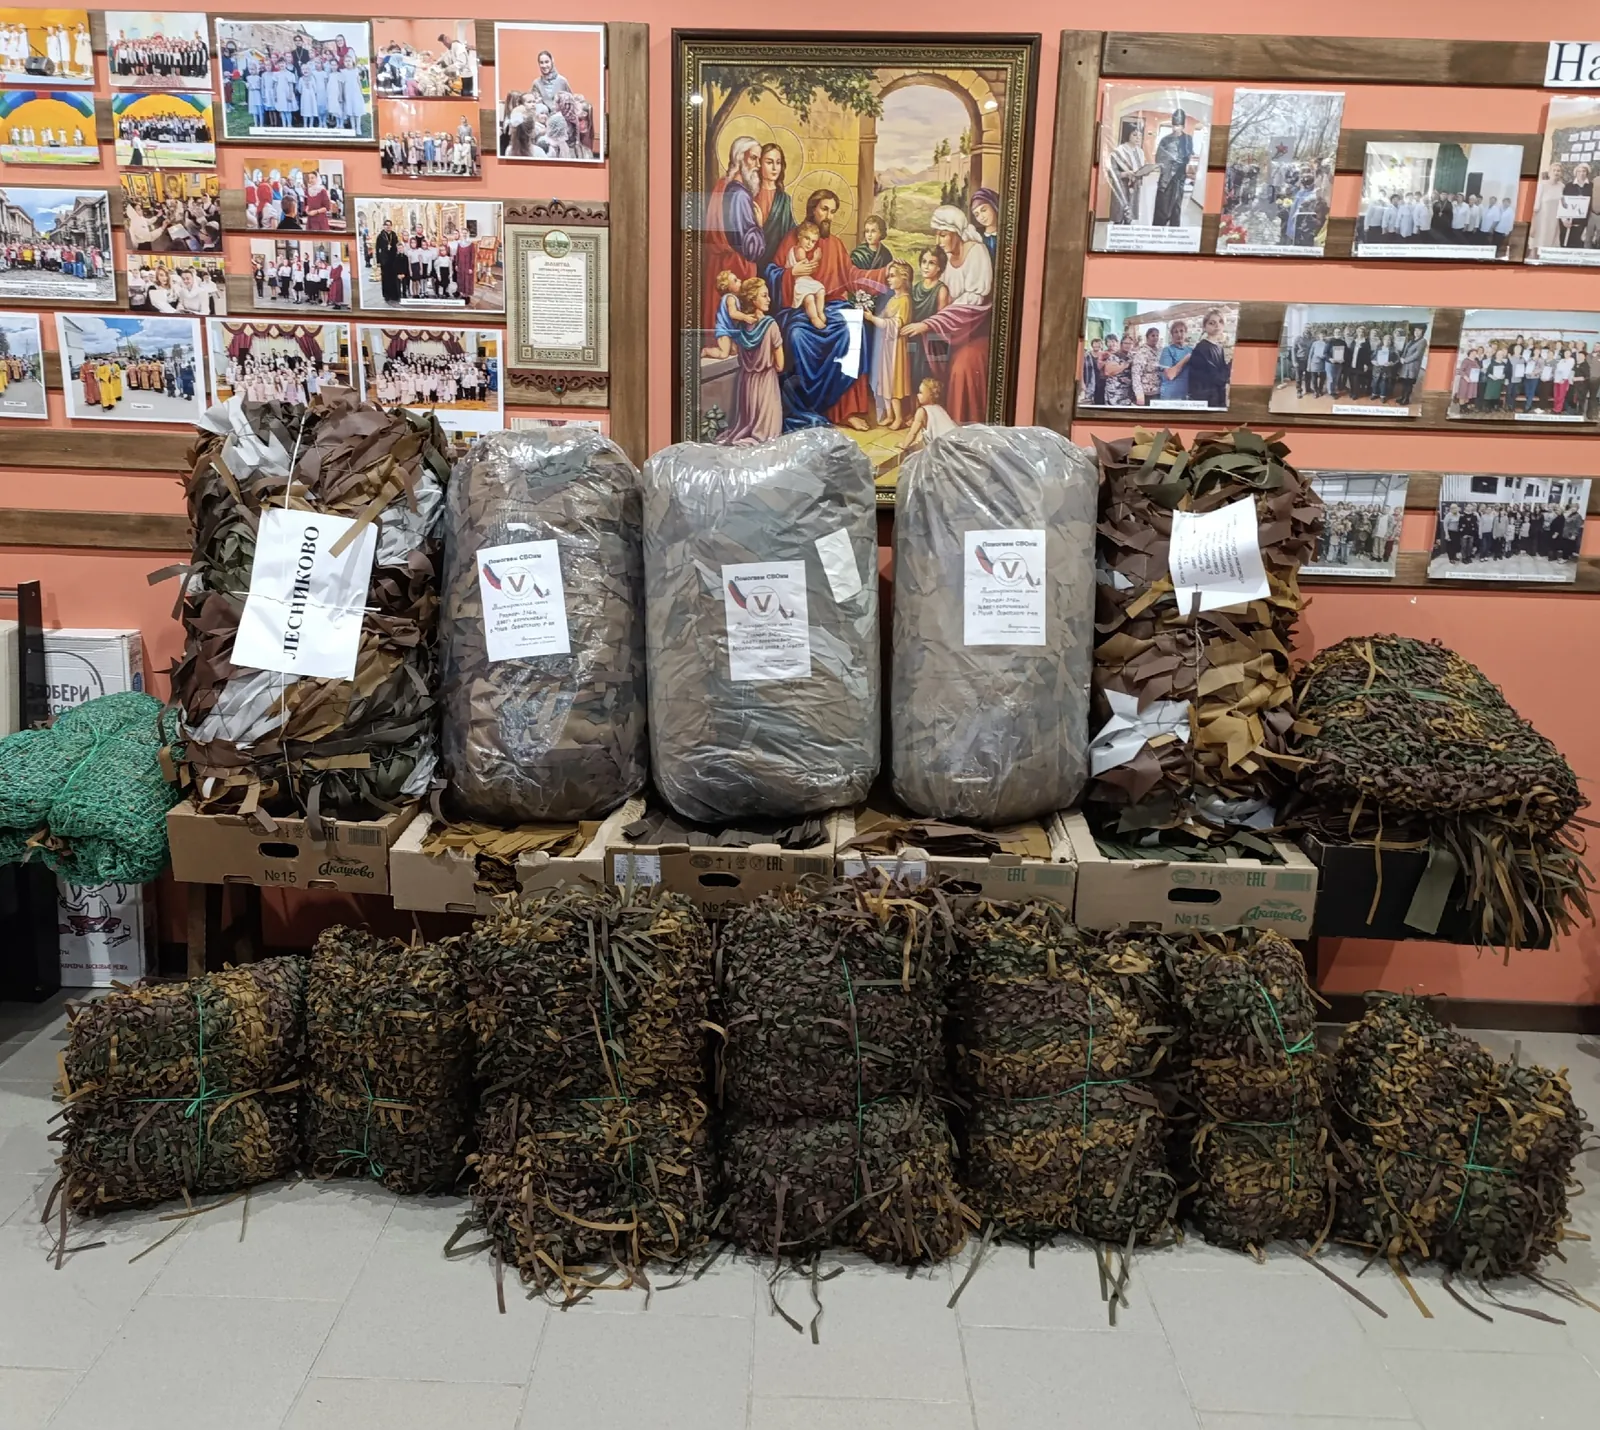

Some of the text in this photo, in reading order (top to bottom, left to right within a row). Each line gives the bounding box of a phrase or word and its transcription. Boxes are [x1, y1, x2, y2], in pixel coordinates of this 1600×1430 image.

[1001, 561, 1020, 579] V
[507, 574, 526, 592] V
[283, 526, 320, 660] ЛЕСНИКОВО
[753, 594, 772, 613] V
[44, 684, 90, 702] ОБЕРИ
[264, 870, 298, 883] №15
[1174, 913, 1210, 926] №15
